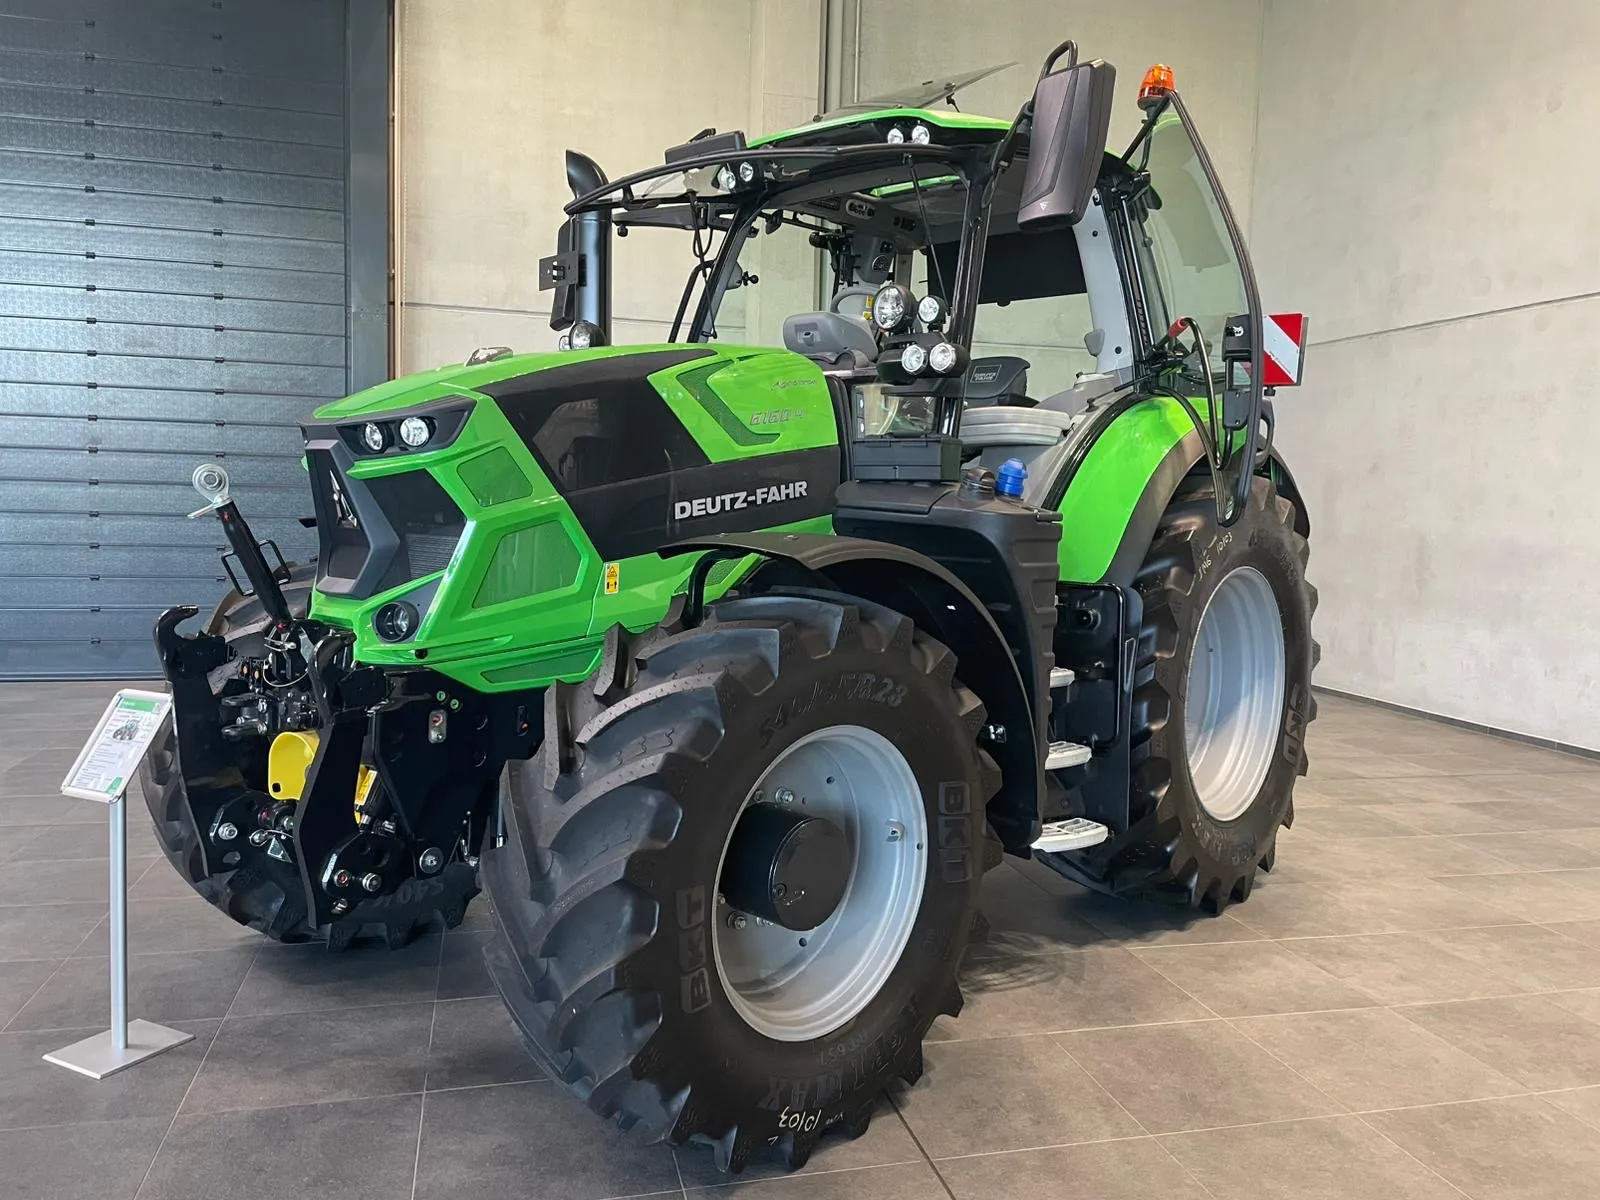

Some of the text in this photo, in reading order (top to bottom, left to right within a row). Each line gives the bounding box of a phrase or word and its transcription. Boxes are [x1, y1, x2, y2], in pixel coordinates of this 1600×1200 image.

[674, 480, 808, 520] DEUTZ-FAHR
[937, 781, 973, 883] BKT
[675, 884, 712, 1014] BKT
